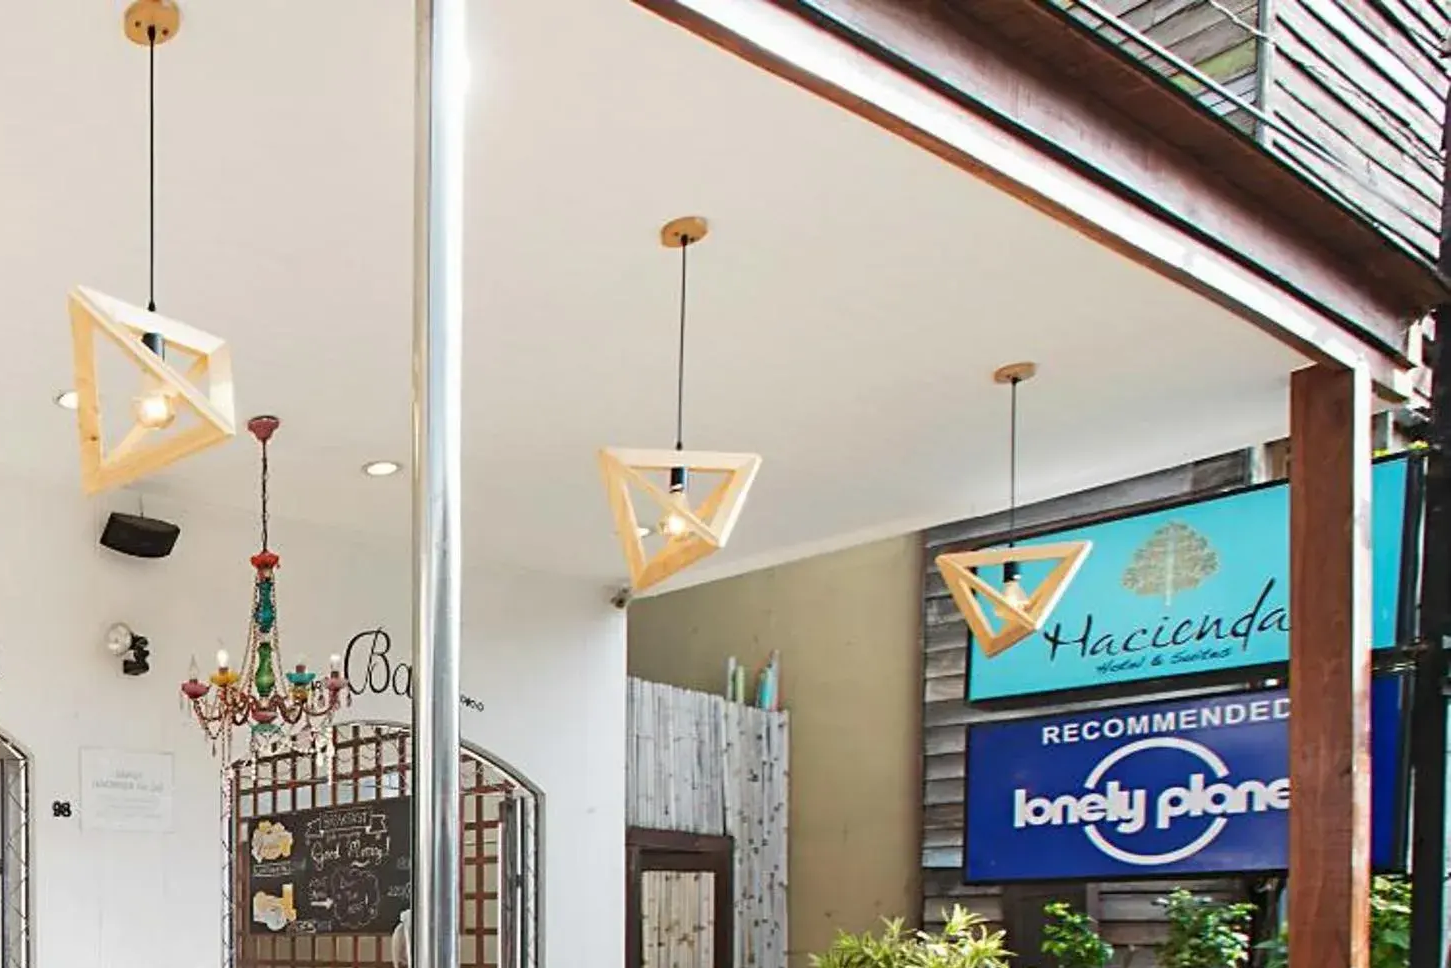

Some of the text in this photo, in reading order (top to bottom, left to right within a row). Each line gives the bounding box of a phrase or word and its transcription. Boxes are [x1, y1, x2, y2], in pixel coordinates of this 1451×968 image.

[1043, 577, 1290, 663] Hacienda
[344, 627, 413, 700] Ba
[1096, 656, 1146, 675] Hotel
[1169, 647, 1232, 666] Suites
[1041, 697, 1291, 747] RECOMMENDED
[52, 800, 73, 818] 98
[1013, 772, 1290, 834] lonely plane
